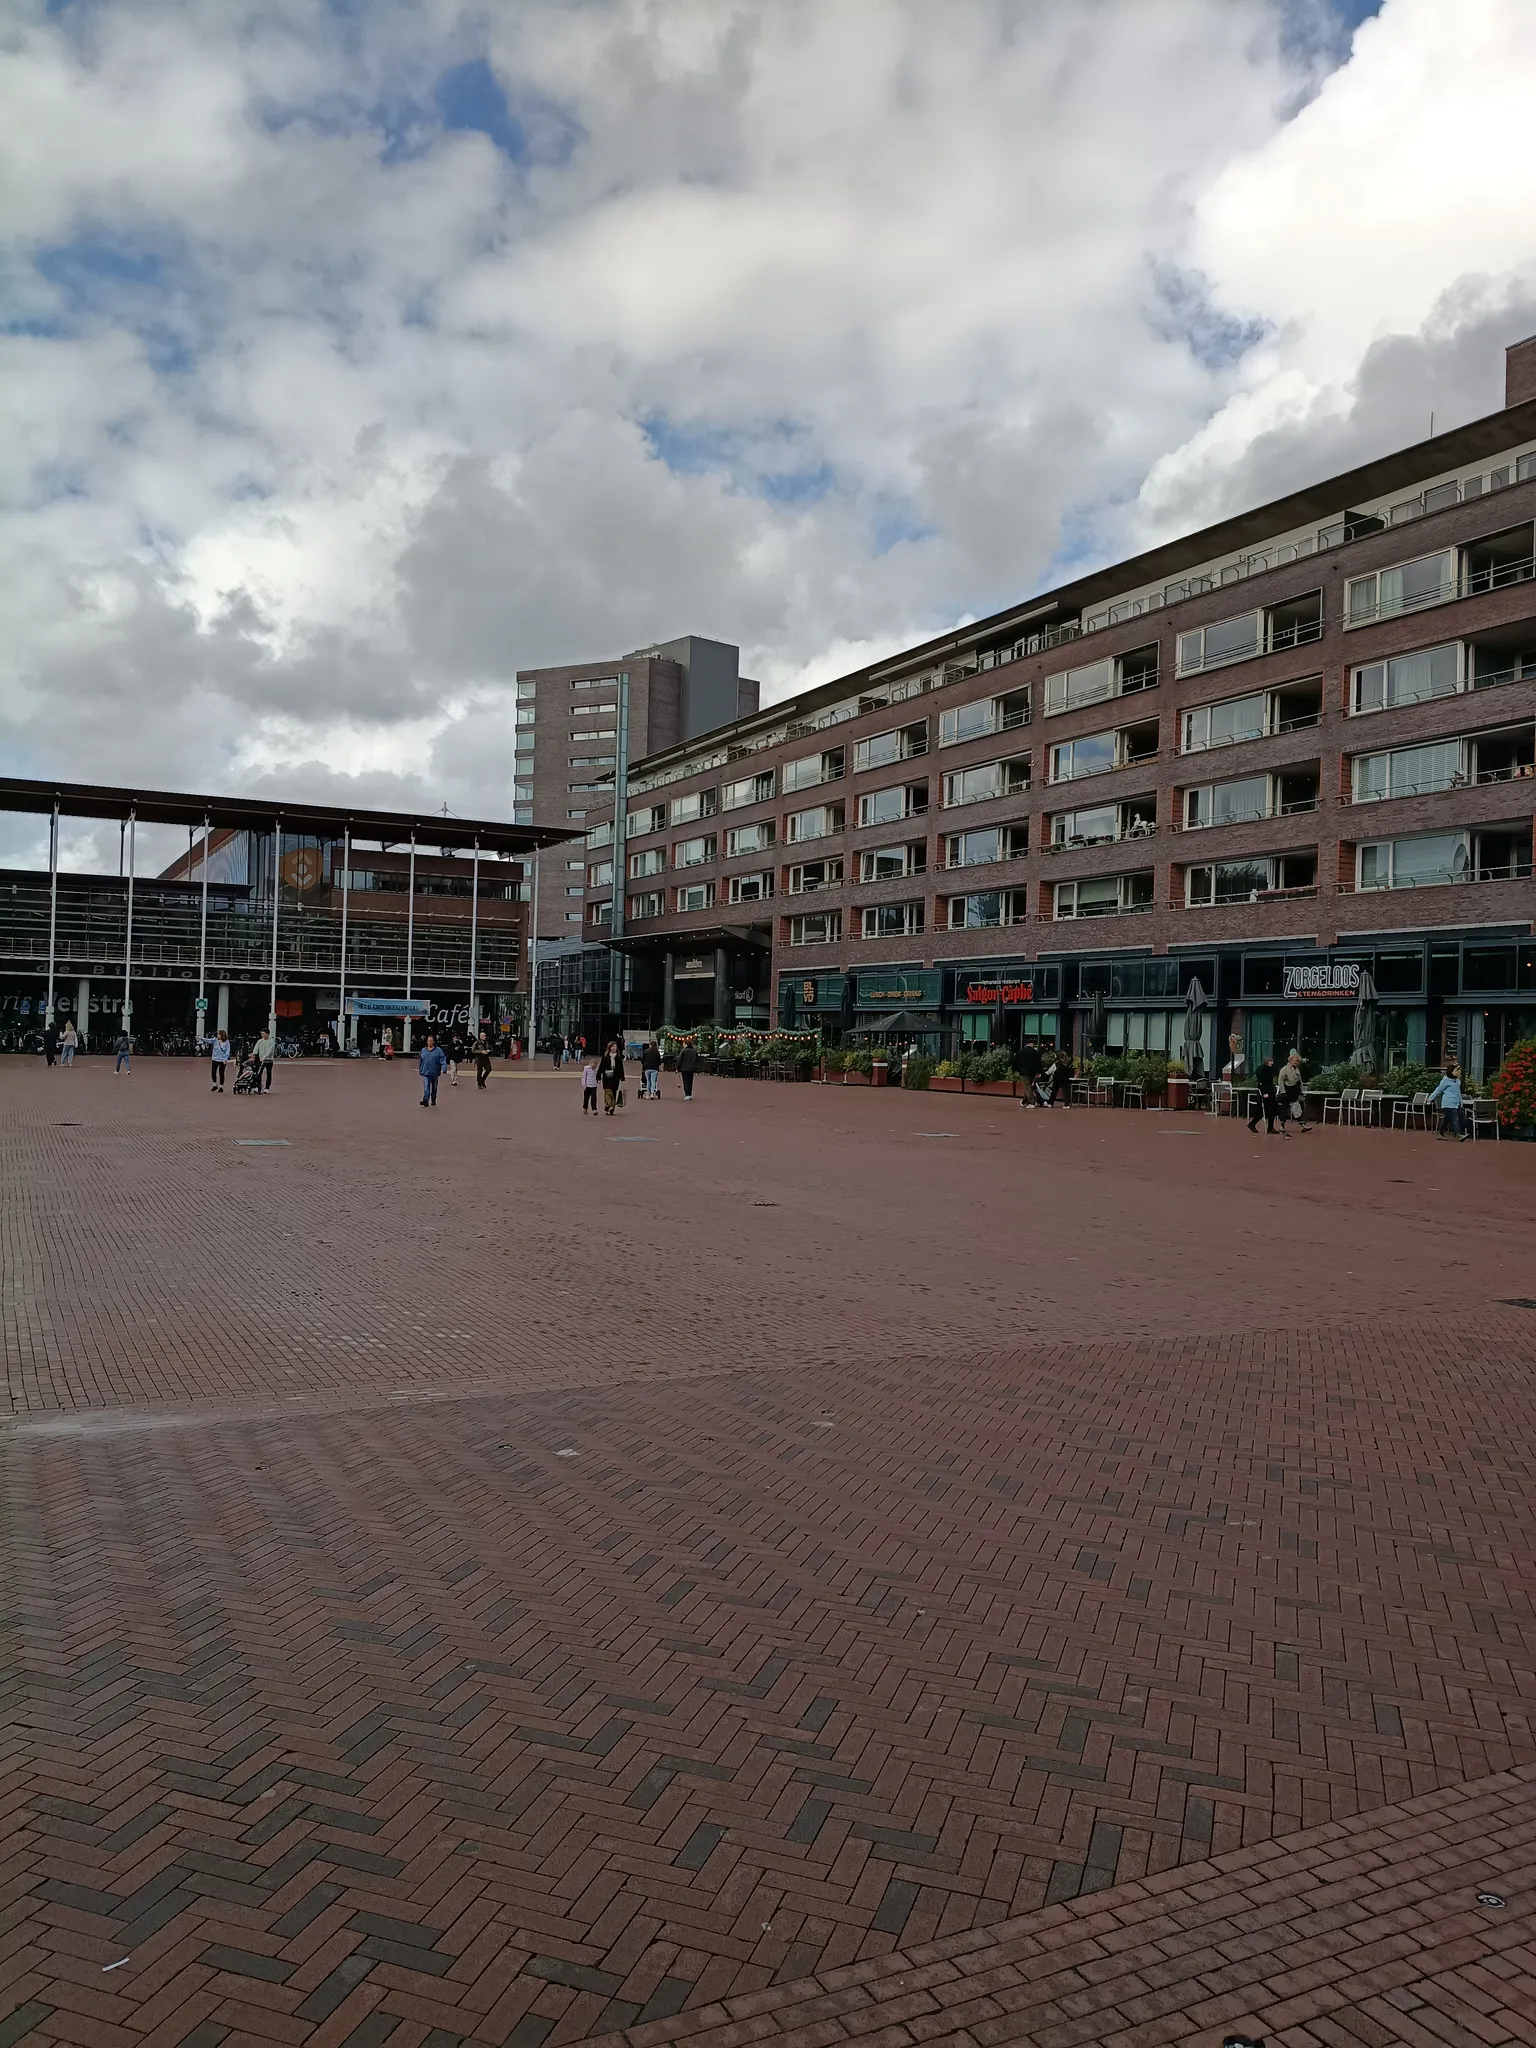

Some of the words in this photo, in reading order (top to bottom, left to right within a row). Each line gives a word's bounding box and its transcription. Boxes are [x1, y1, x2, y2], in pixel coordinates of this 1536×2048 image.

[36, 962, 71, 974] de
[92, 964, 291, 983] Bibliotheek
[1283, 964, 1360, 998] ZORGELOOS
[803, 981, 814, 991] BL
[803, 993, 814, 1003] VD
[424, 1002, 470, 1028] Café
